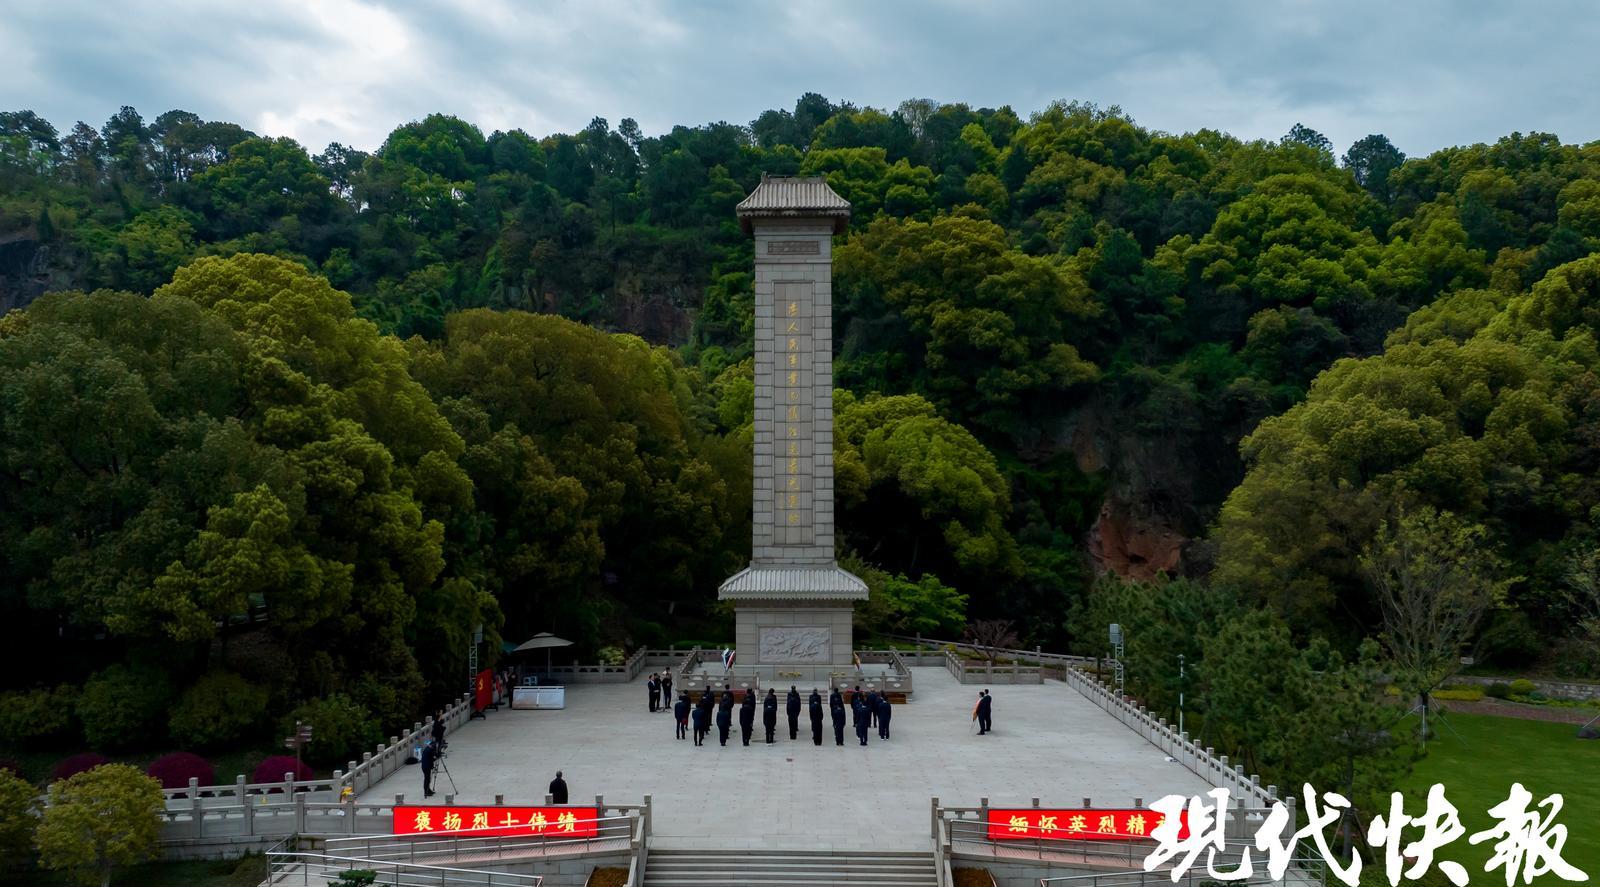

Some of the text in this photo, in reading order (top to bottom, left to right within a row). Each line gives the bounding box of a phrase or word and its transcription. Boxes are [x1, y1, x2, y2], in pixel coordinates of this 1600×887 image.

[413, 810, 577, 832] 褒扬烈士伟绩
[1008, 813, 1166, 835] 缅怀英烈精
